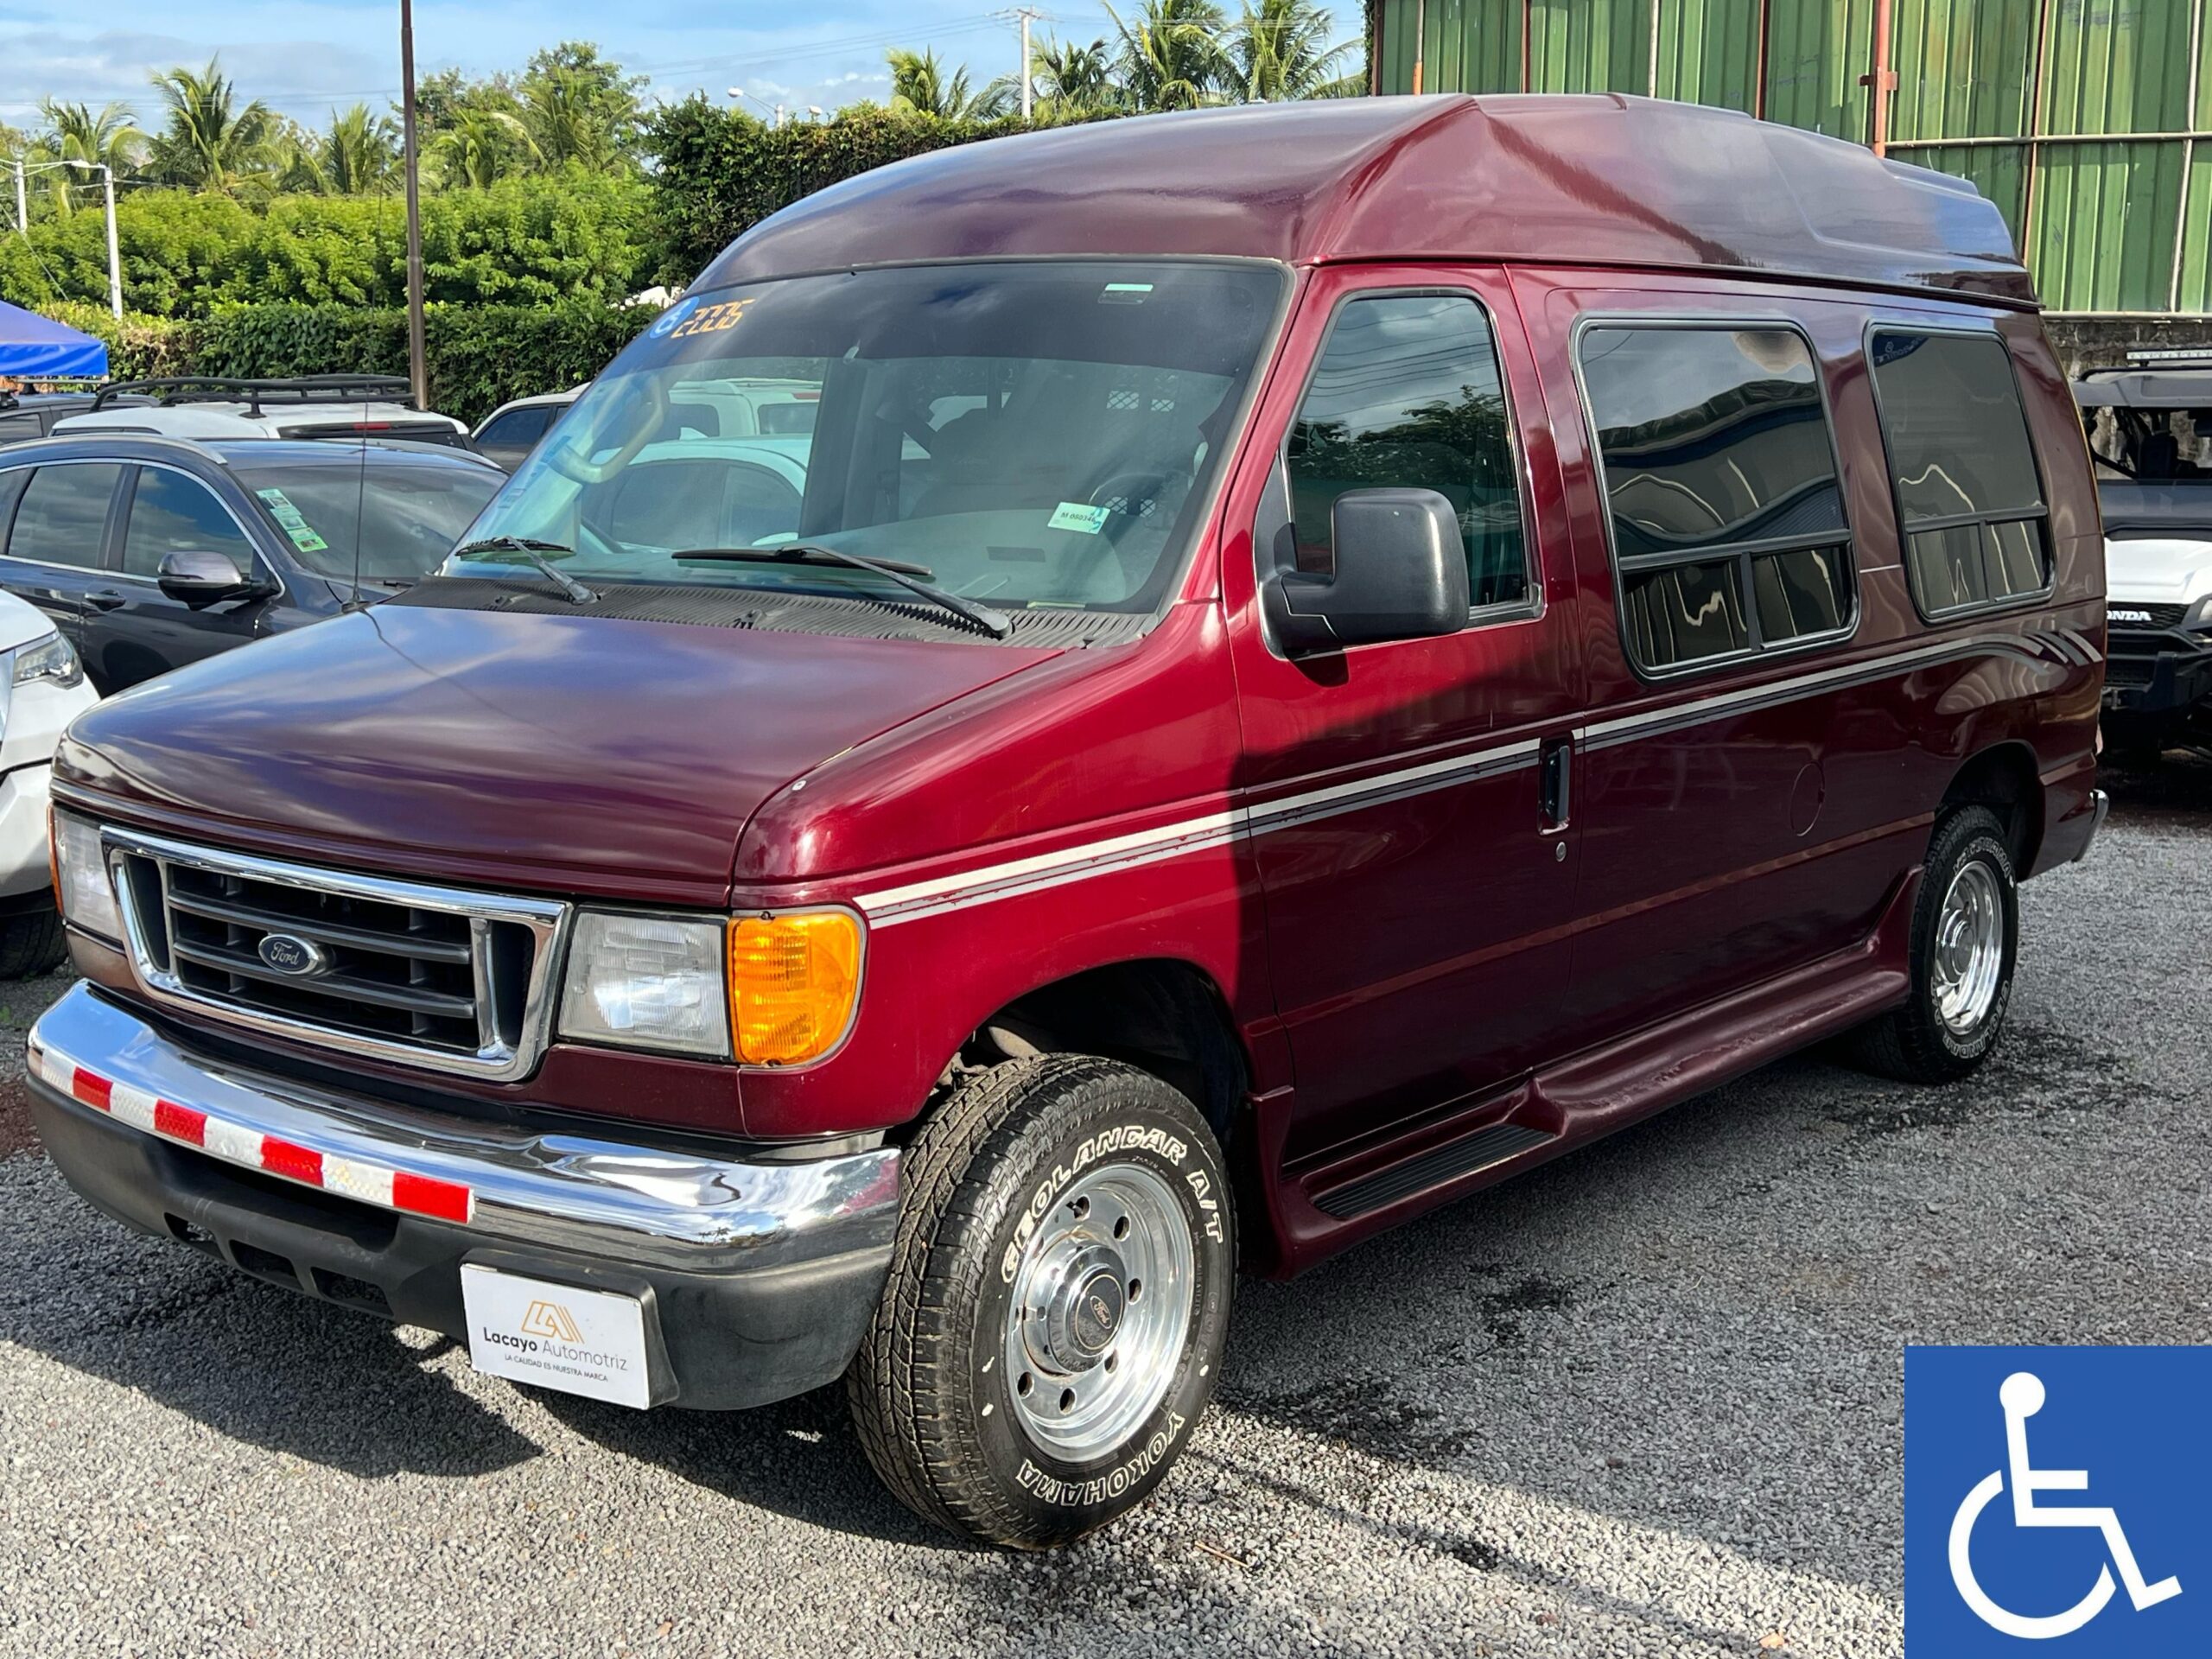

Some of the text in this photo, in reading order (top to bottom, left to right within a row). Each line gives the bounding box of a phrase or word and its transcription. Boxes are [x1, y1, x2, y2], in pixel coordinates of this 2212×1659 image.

[2107, 610, 2152, 621] NDA
[270, 942, 300, 965] Ford
[1185, 1168, 1224, 1244] A/T
[483, 1326, 628, 1371] Lacayo Automotriz
[513, 1355, 543, 1369] CALIDAD
[543, 1362, 551, 1370] ES
[553, 1364, 582, 1376] NUESTRA
[583, 1371, 608, 1382] MARCA
[1015, 1411, 1185, 1507] YOKOHAMA
